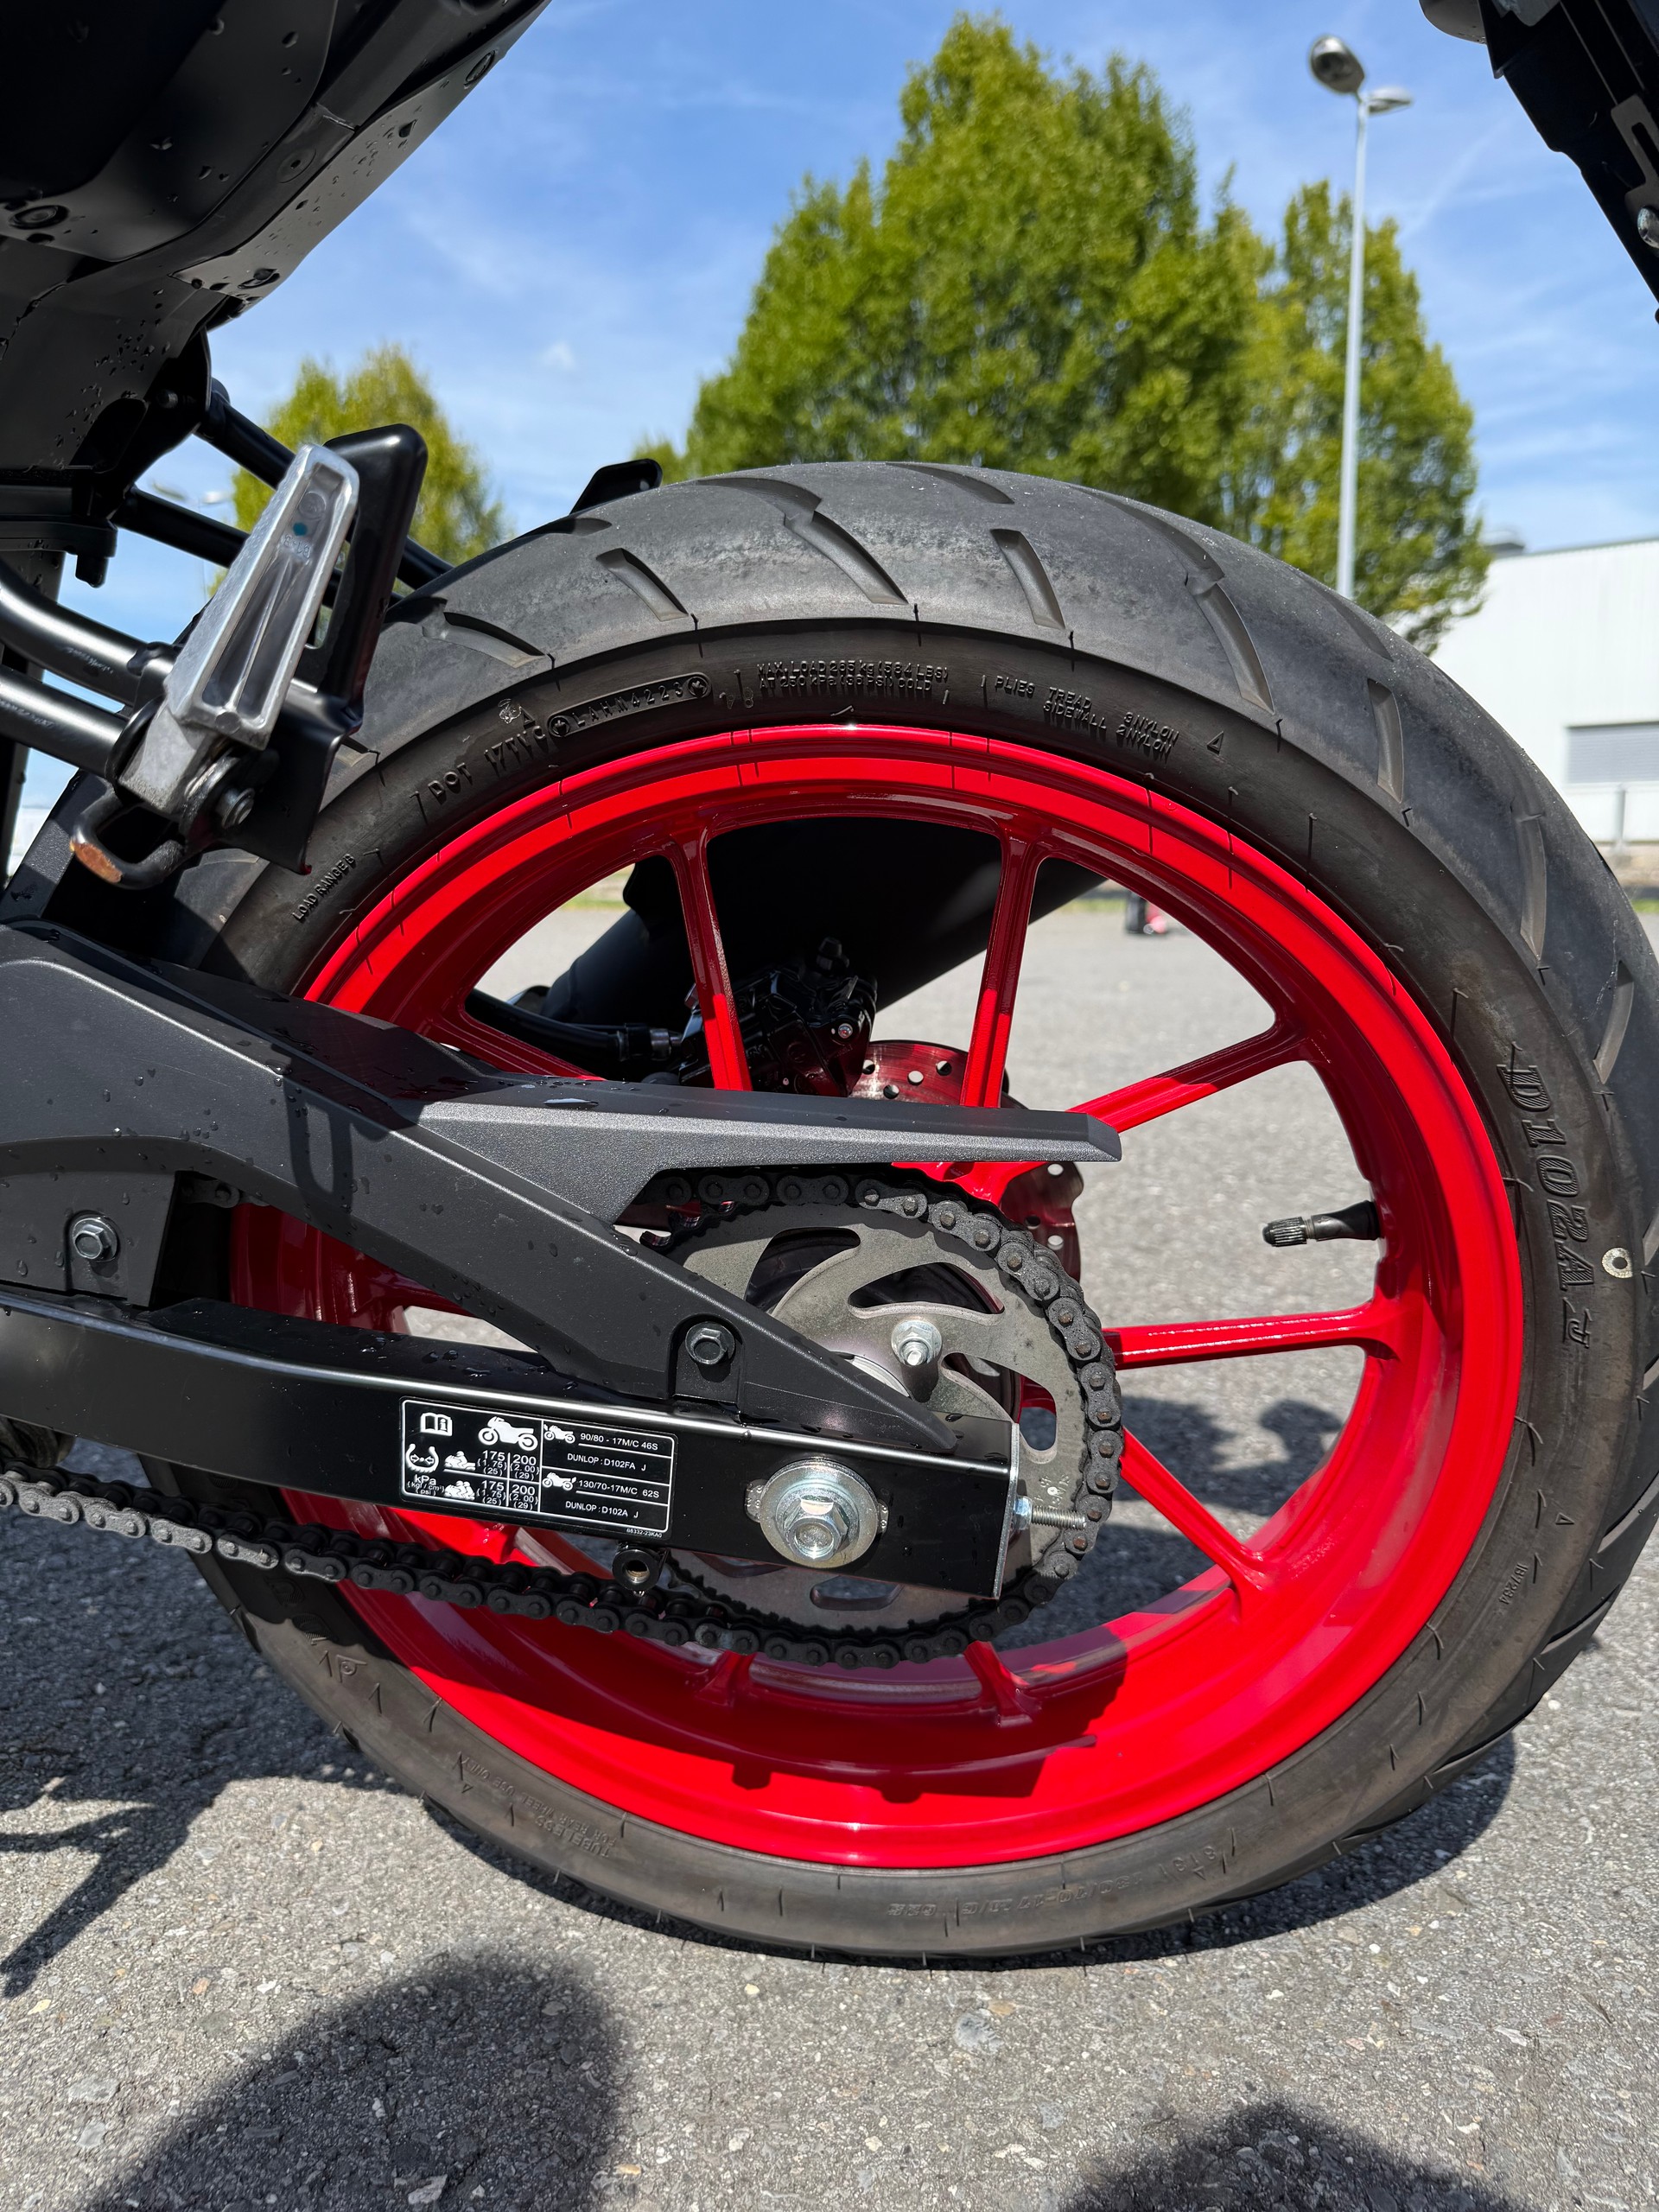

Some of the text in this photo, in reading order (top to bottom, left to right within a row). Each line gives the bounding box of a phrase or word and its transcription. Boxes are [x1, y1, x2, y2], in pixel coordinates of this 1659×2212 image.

[791, 659, 826, 673] LOAD
[830, 659, 855, 672] 265
[859, 659, 874, 675] kg
[760, 677, 775, 689] AT
[780, 675, 806, 688] 250
[810, 674, 837, 686] kPa
[899, 677, 932, 691] COLD
[995, 675, 1035, 695] PLIES
[1048, 686, 1092, 710] TREAD
[1042, 700, 1107, 729] SIDEWALL
[427, 762, 473, 797] DOT
[292, 852, 355, 920] LOAD RANGE B
[1496, 1063, 1595, 1292] D102A
[580, 1433, 605, 1444] 90/80
[612, 1437, 639, 1448] 17M/C
[640, 1440, 659, 1451] 46S
[481, 1449, 537, 1466] 175 200
[567, 1452, 600, 1465] DUNLOP
[414, 1473, 437, 1486] kPa
[480, 1479, 536, 1497] 175 200
[578, 1478, 660, 1499] 130/70-17M/C 62S
[565, 1500, 598, 1513] DUNLOP
[534, 1815, 609, 1858] TUBELESS
